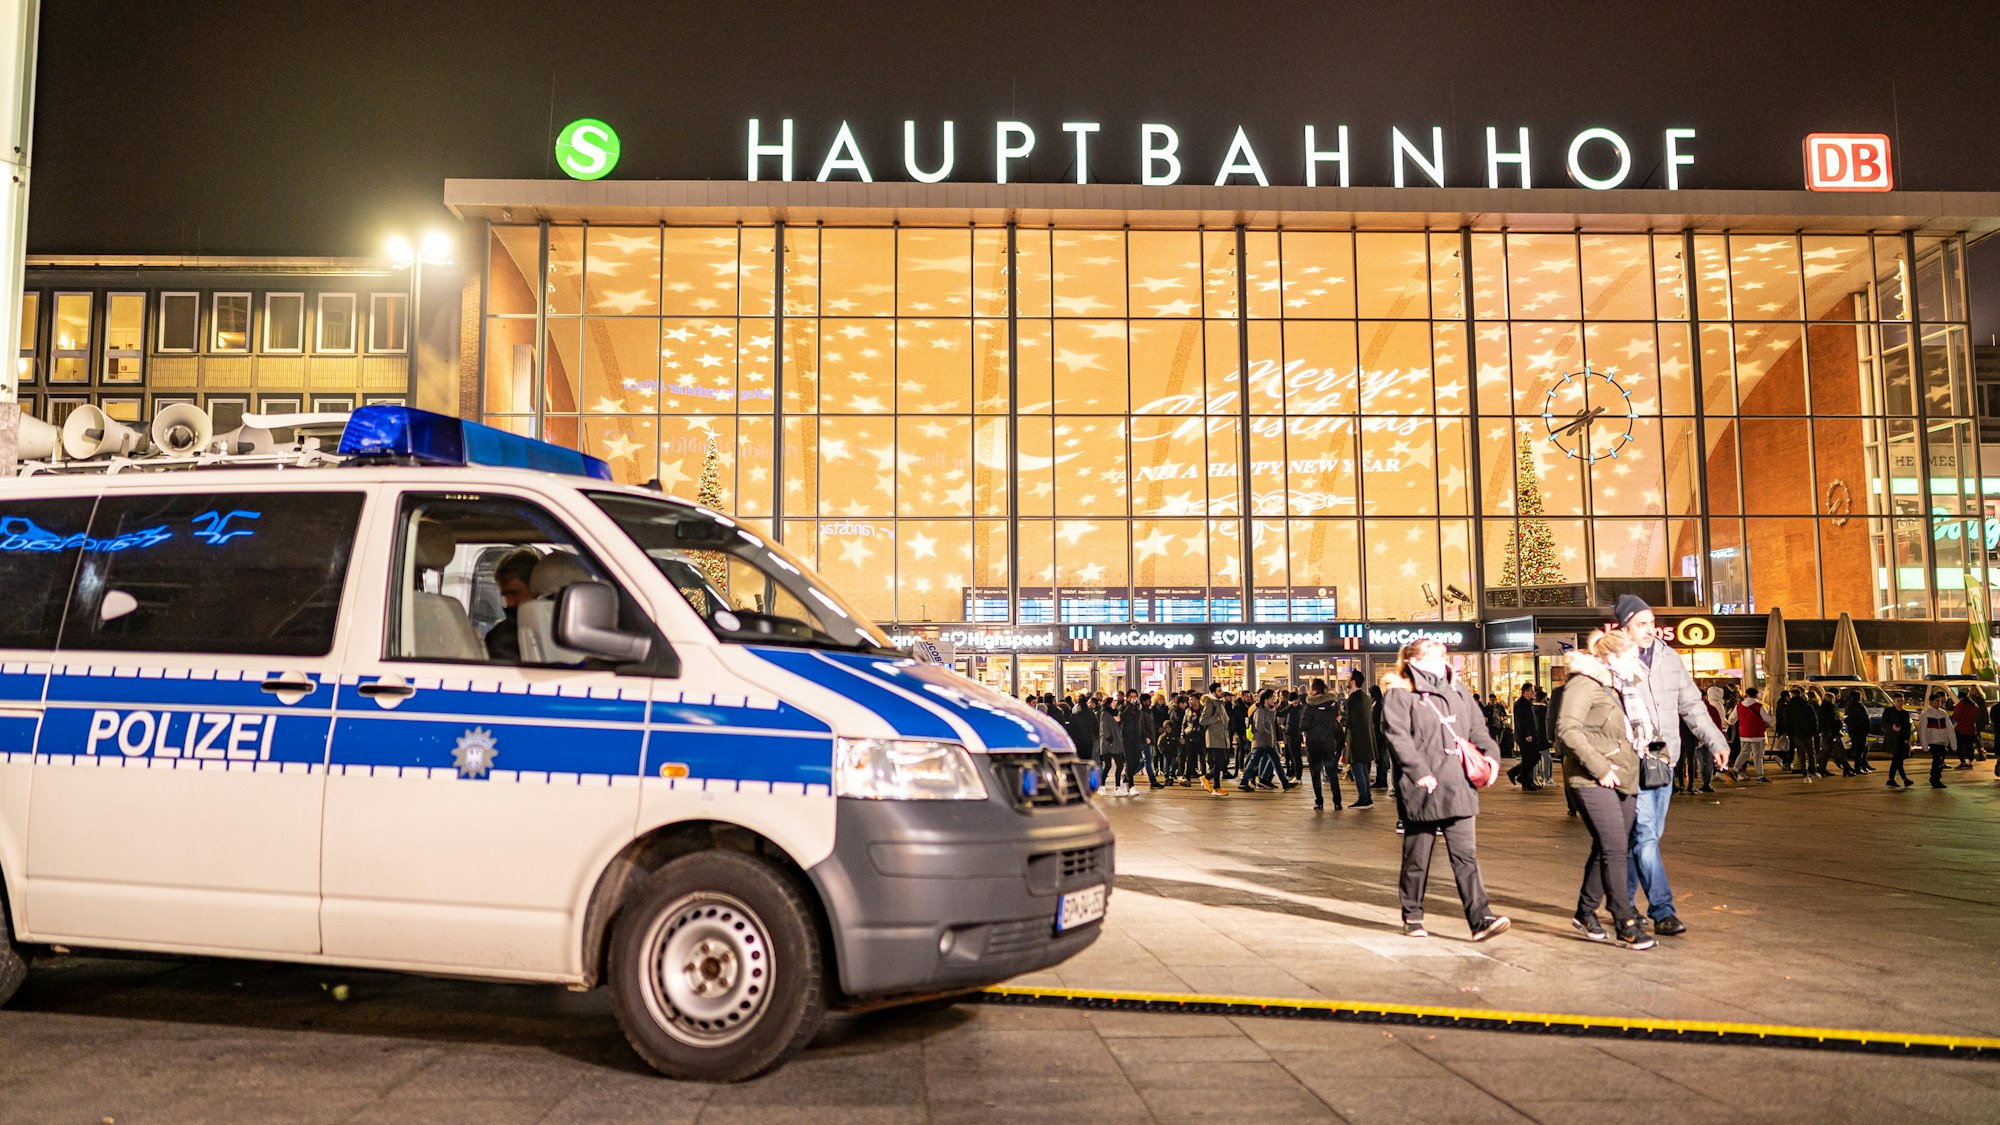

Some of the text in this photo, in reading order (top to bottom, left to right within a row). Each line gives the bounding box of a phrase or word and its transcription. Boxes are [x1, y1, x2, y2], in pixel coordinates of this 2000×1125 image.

[565, 125, 609, 173] S
[747, 118, 1696, 191] HAUPTBAHNHOF
[1817, 143, 1881, 182] DB
[1224, 358, 1405, 402] Merry
[1117, 391, 1430, 442] Christmas
[1181, 464, 1199, 479] A
[1207, 460, 1283, 478] HAPPY
[1288, 459, 1338, 473] NEW
[1342, 459, 1401, 473] YEAR
[1895, 456, 1956, 467] HEMES
[968, 631, 1053, 650] Highspeed
[1099, 631, 1195, 649] NetCologne
[1239, 630, 1324, 648] Highspeed
[86, 710, 277, 761] POLIZEI
